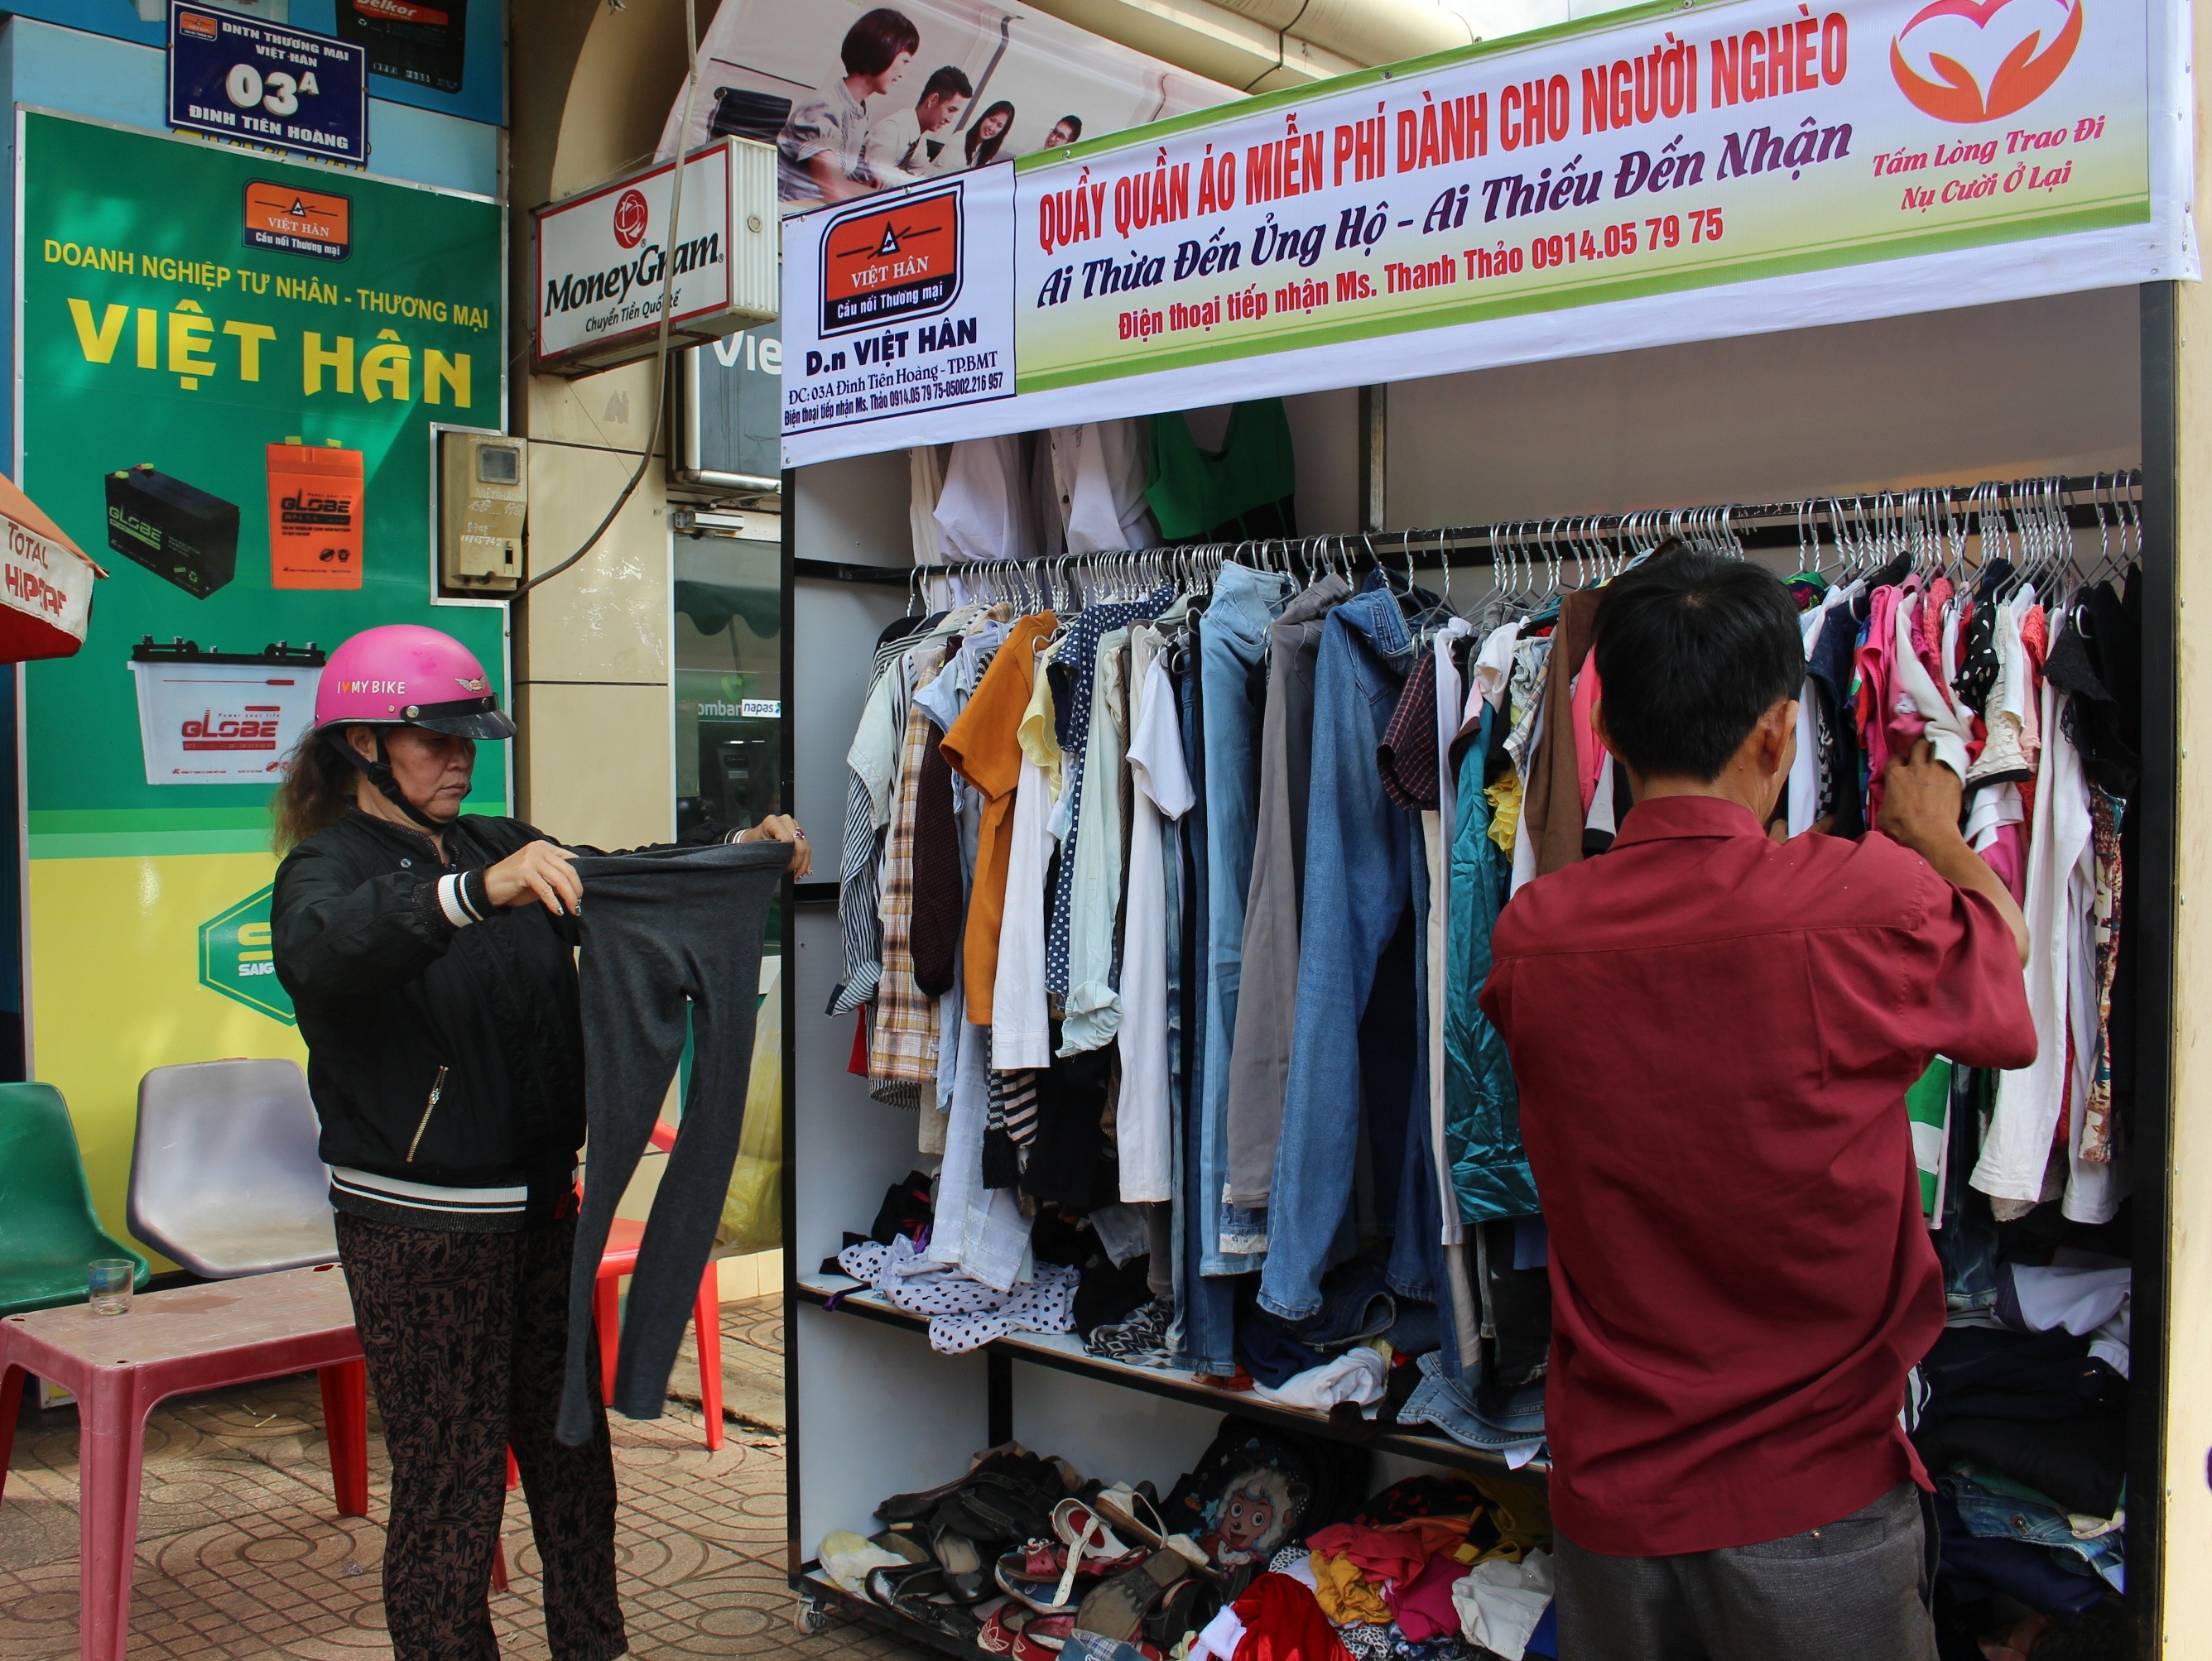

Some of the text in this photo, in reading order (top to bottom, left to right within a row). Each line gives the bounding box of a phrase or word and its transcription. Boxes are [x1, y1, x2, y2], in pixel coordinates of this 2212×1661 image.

[222, 22, 260, 40] DNTN
[263, 31, 320, 55] THƯƠNG
[323, 46, 349, 61] MẠI
[255, 44, 286, 60] VIỆT
[189, 104, 236, 126] ĐINH
[241, 118, 282, 137] TIÊN
[287, 125, 349, 150] HOÀNG
[1039, 3, 1849, 255] QUẦY QUẦN ÁO MIỄN PHÍ DÀNH CHO NGƯỜI NGHÈO
[1873, 114, 2106, 178] Tấm Lòng Trao Đi
[1901, 160, 2073, 214] Nụ Cười Ở Lại
[267, 216, 330, 238] VIỆT HÂN
[1036, 264, 1073, 310] Ai
[1081, 248, 1166, 300] Thừa
[1173, 227, 1242, 281] Đến
[1250, 212, 1327, 267] Ủng
[1334, 201, 1388, 257] Hộ
[1422, 184, 1469, 236] Ai
[1481, 154, 1604, 224] Thiếu
[1614, 134, 1707, 200] Đến
[1716, 116, 1854, 181] Nhận
[291, 238, 323, 254] Thương
[324, 245, 340, 257] mại
[43, 239, 135, 276] DOANH
[142, 256, 231, 294] NGHIỆP
[237, 269, 271, 293] TƯ
[275, 276, 338, 308] NHÂN
[357, 289, 448, 324] THƯƠNG
[453, 304, 489, 333] MẠI
[544, 232, 719, 318] MoneyGram
[851, 255, 930, 290] VIỆT HÂN
[1118, 207, 1724, 343] Điện thoại tiếp nhận Ms. Thanh Thảo 0914.05 79 75
[585, 307, 618, 333] Chuyển
[621, 300, 640, 324] Tiền
[642, 294, 665, 318] Quố
[837, 281, 943, 319] Cầu nối Thương mại
[67, 297, 472, 409] VIỆT HÂN
[806, 317, 977, 377] D.n VIỆT HÂN
[836, 377, 867, 396] Đinh
[868, 372, 894, 390] Tiên
[896, 365, 940, 386] Hoàng
[947, 351, 998, 375] TP.BMT
[784, 410, 801, 429] Điện
[802, 405, 820, 425] thoại
[820, 398, 834, 420] tiếp
[835, 400, 854, 419] nhận
[855, 396, 869, 412] Ms.
[870, 391, 888, 411] Thảo
[889, 387, 921, 406] 0914.05
[921, 384, 932, 401] 79
[988, 372, 1004, 390] 957
[281, 487, 351, 513] GLOBE
[108, 503, 162, 542] GLOBE
[8, 521, 49, 570] TOTAL
[351, 680, 369, 694] MY
[372, 680, 406, 694] BIKE
[181, 708, 279, 737] GLOBE
[743, 703, 774, 715] napas
[238, 962, 275, 977] SAIG
